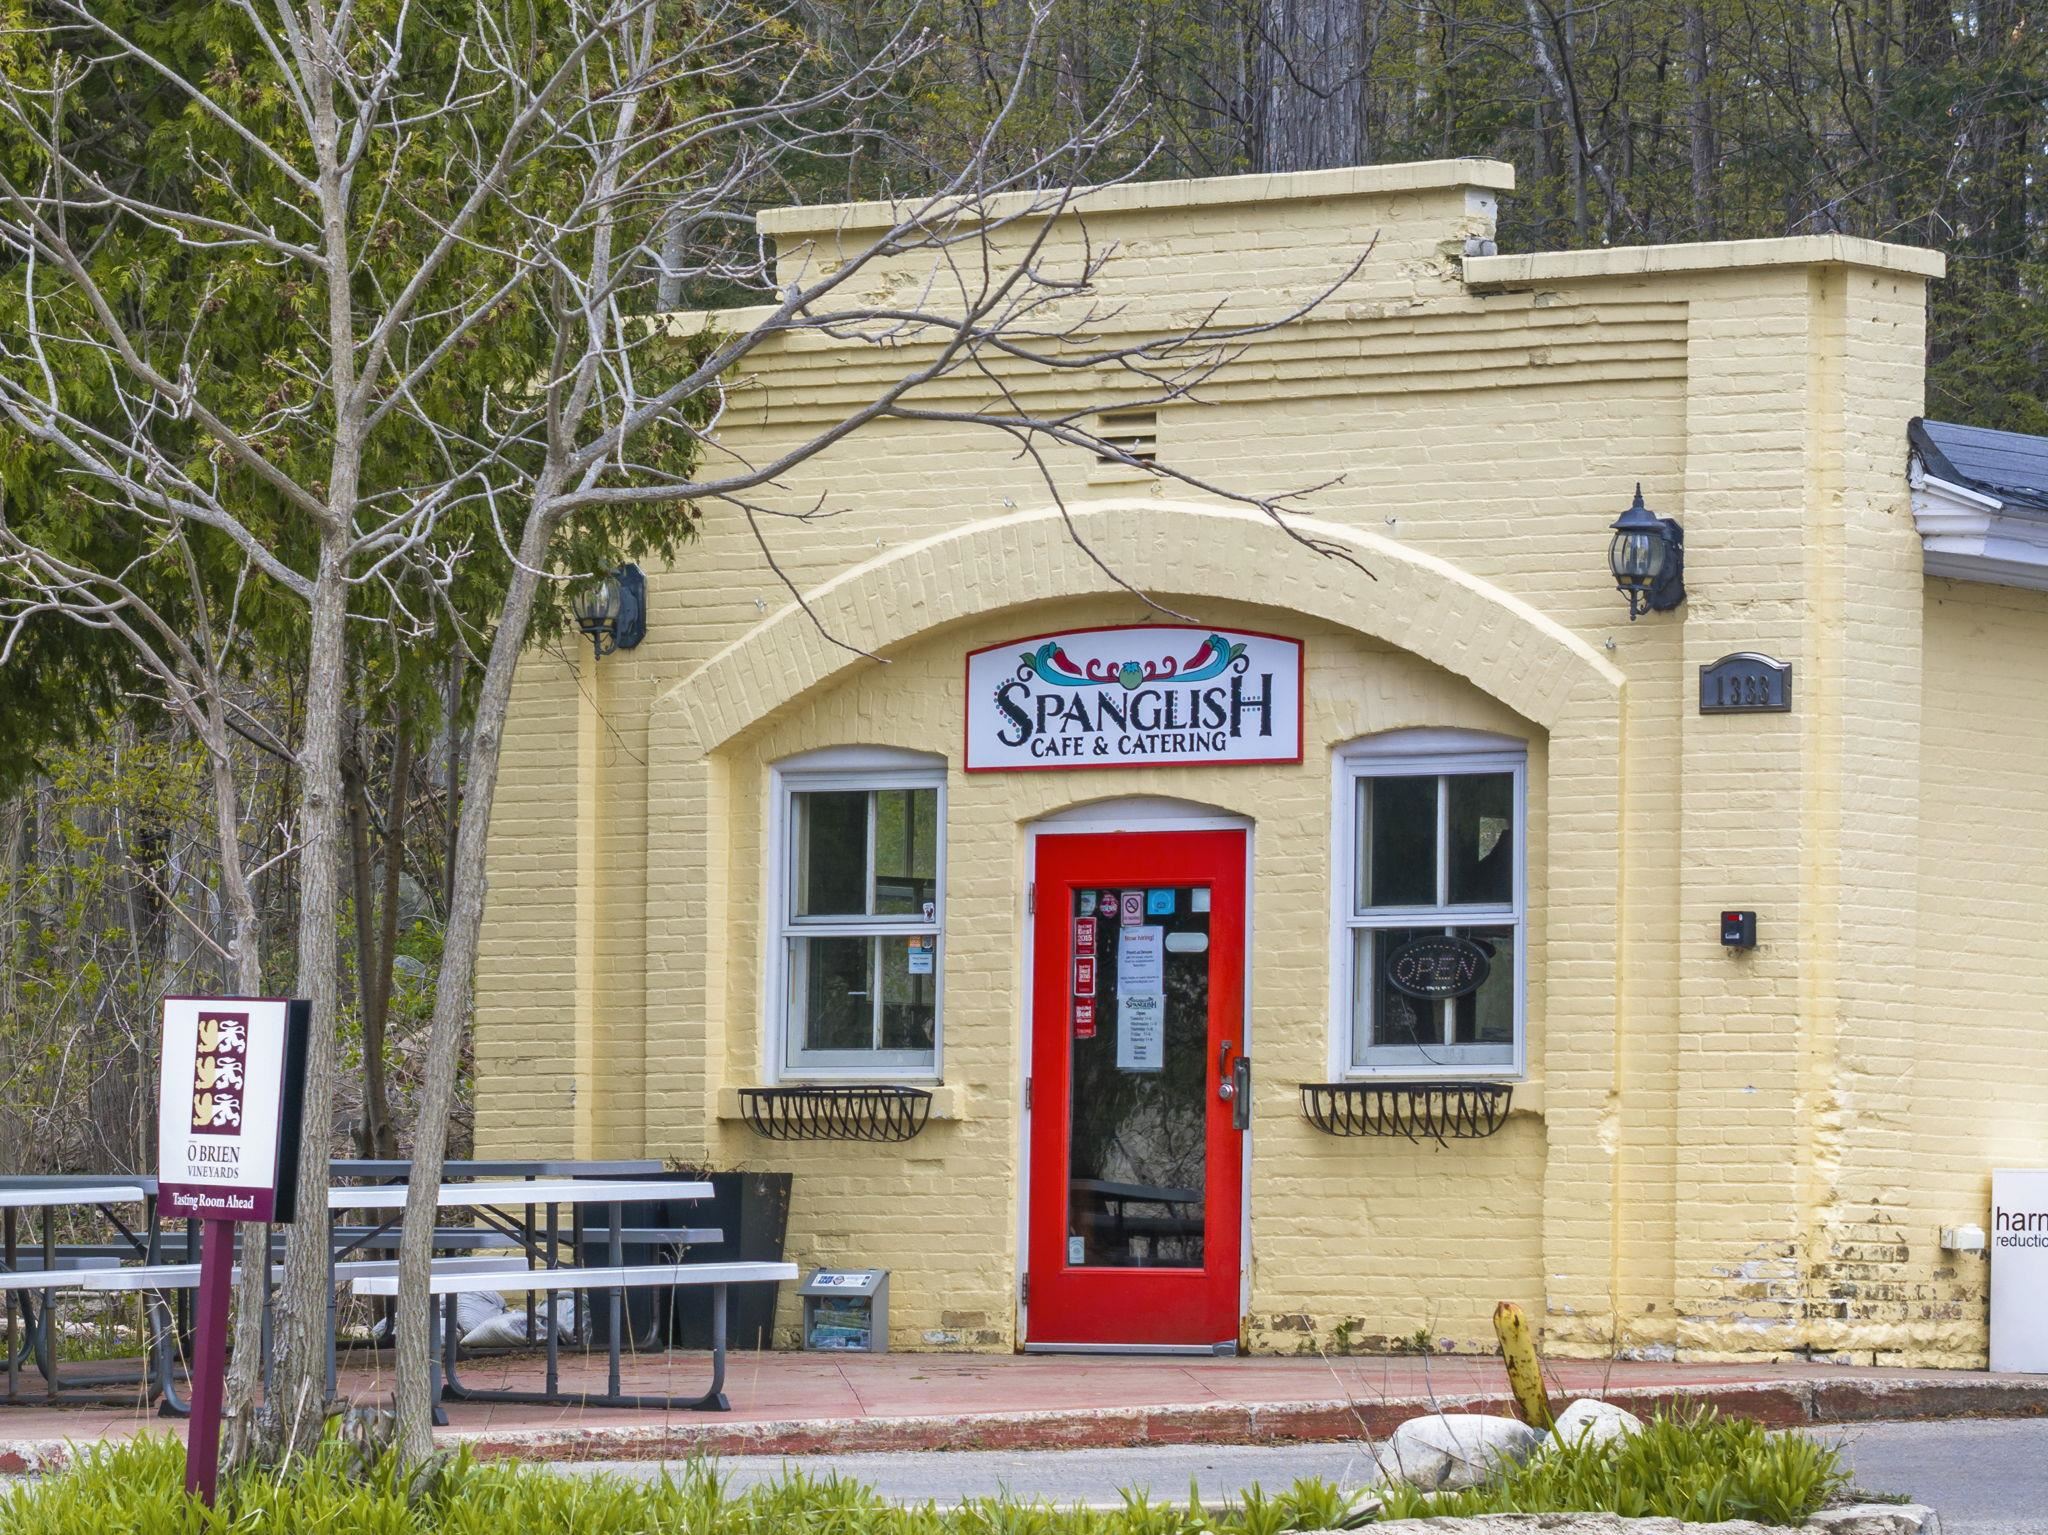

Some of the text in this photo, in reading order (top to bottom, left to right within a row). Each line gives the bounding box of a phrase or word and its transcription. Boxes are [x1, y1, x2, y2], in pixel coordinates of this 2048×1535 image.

[994, 673, 1273, 747] SPANGLISH
[1031, 731, 1227, 758] CAFE & CATERING
[1397, 957, 1478, 980] OPEN
[187, 1165, 239, 1179] VINEYARDS
[172, 1192, 254, 1210] Tasting Room Ahead
